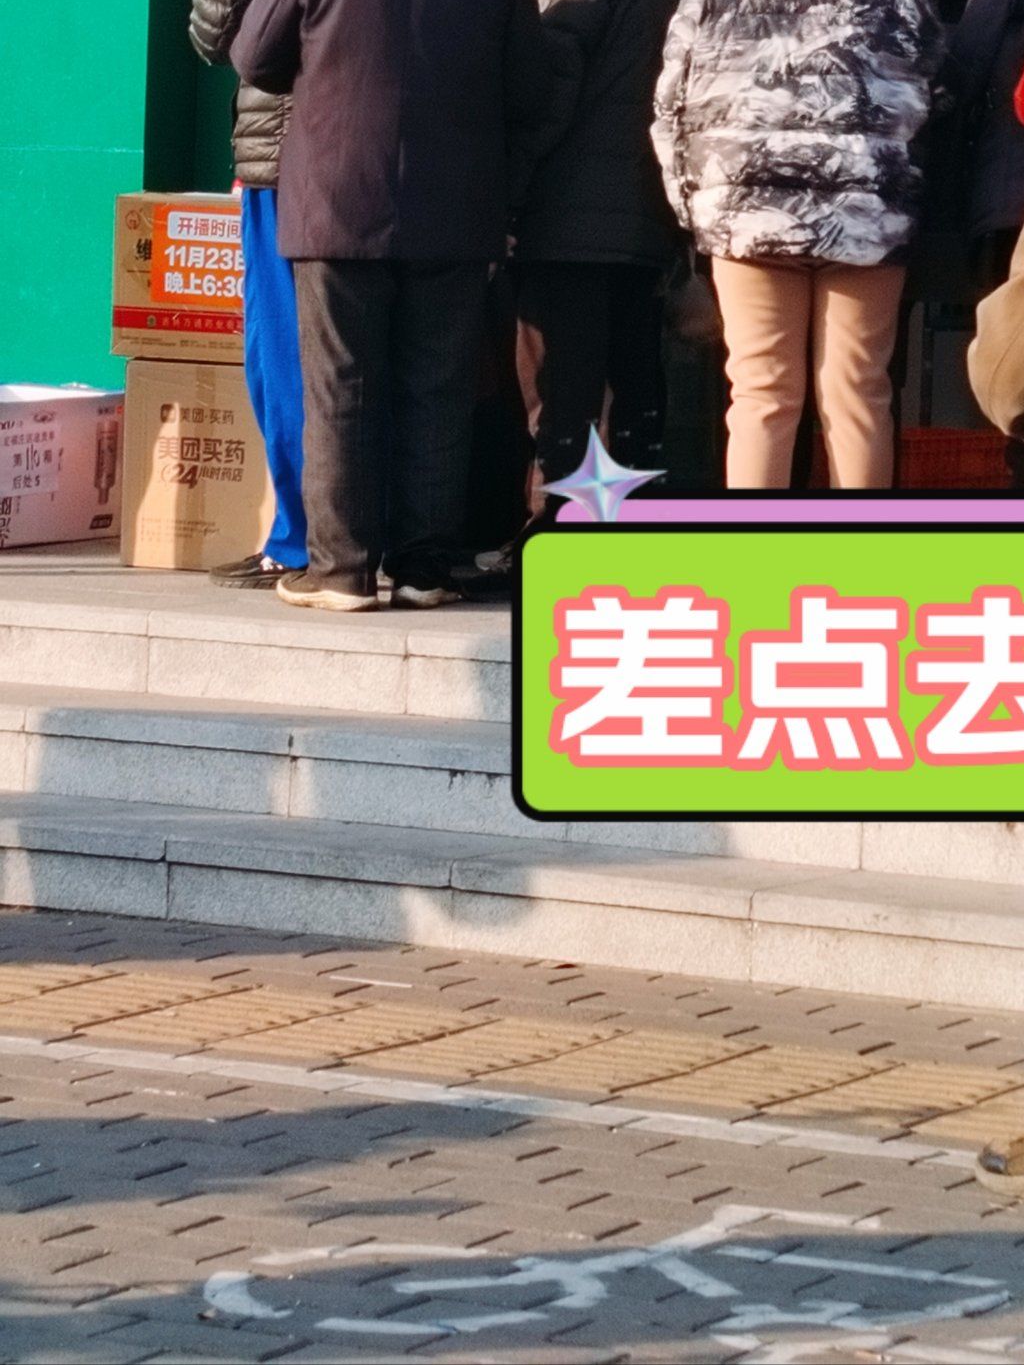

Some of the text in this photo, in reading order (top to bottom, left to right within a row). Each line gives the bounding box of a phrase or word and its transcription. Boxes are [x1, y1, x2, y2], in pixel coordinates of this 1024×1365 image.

[177, 217, 242, 239] 开播时间
[158, 436, 246, 466] 美团买药
